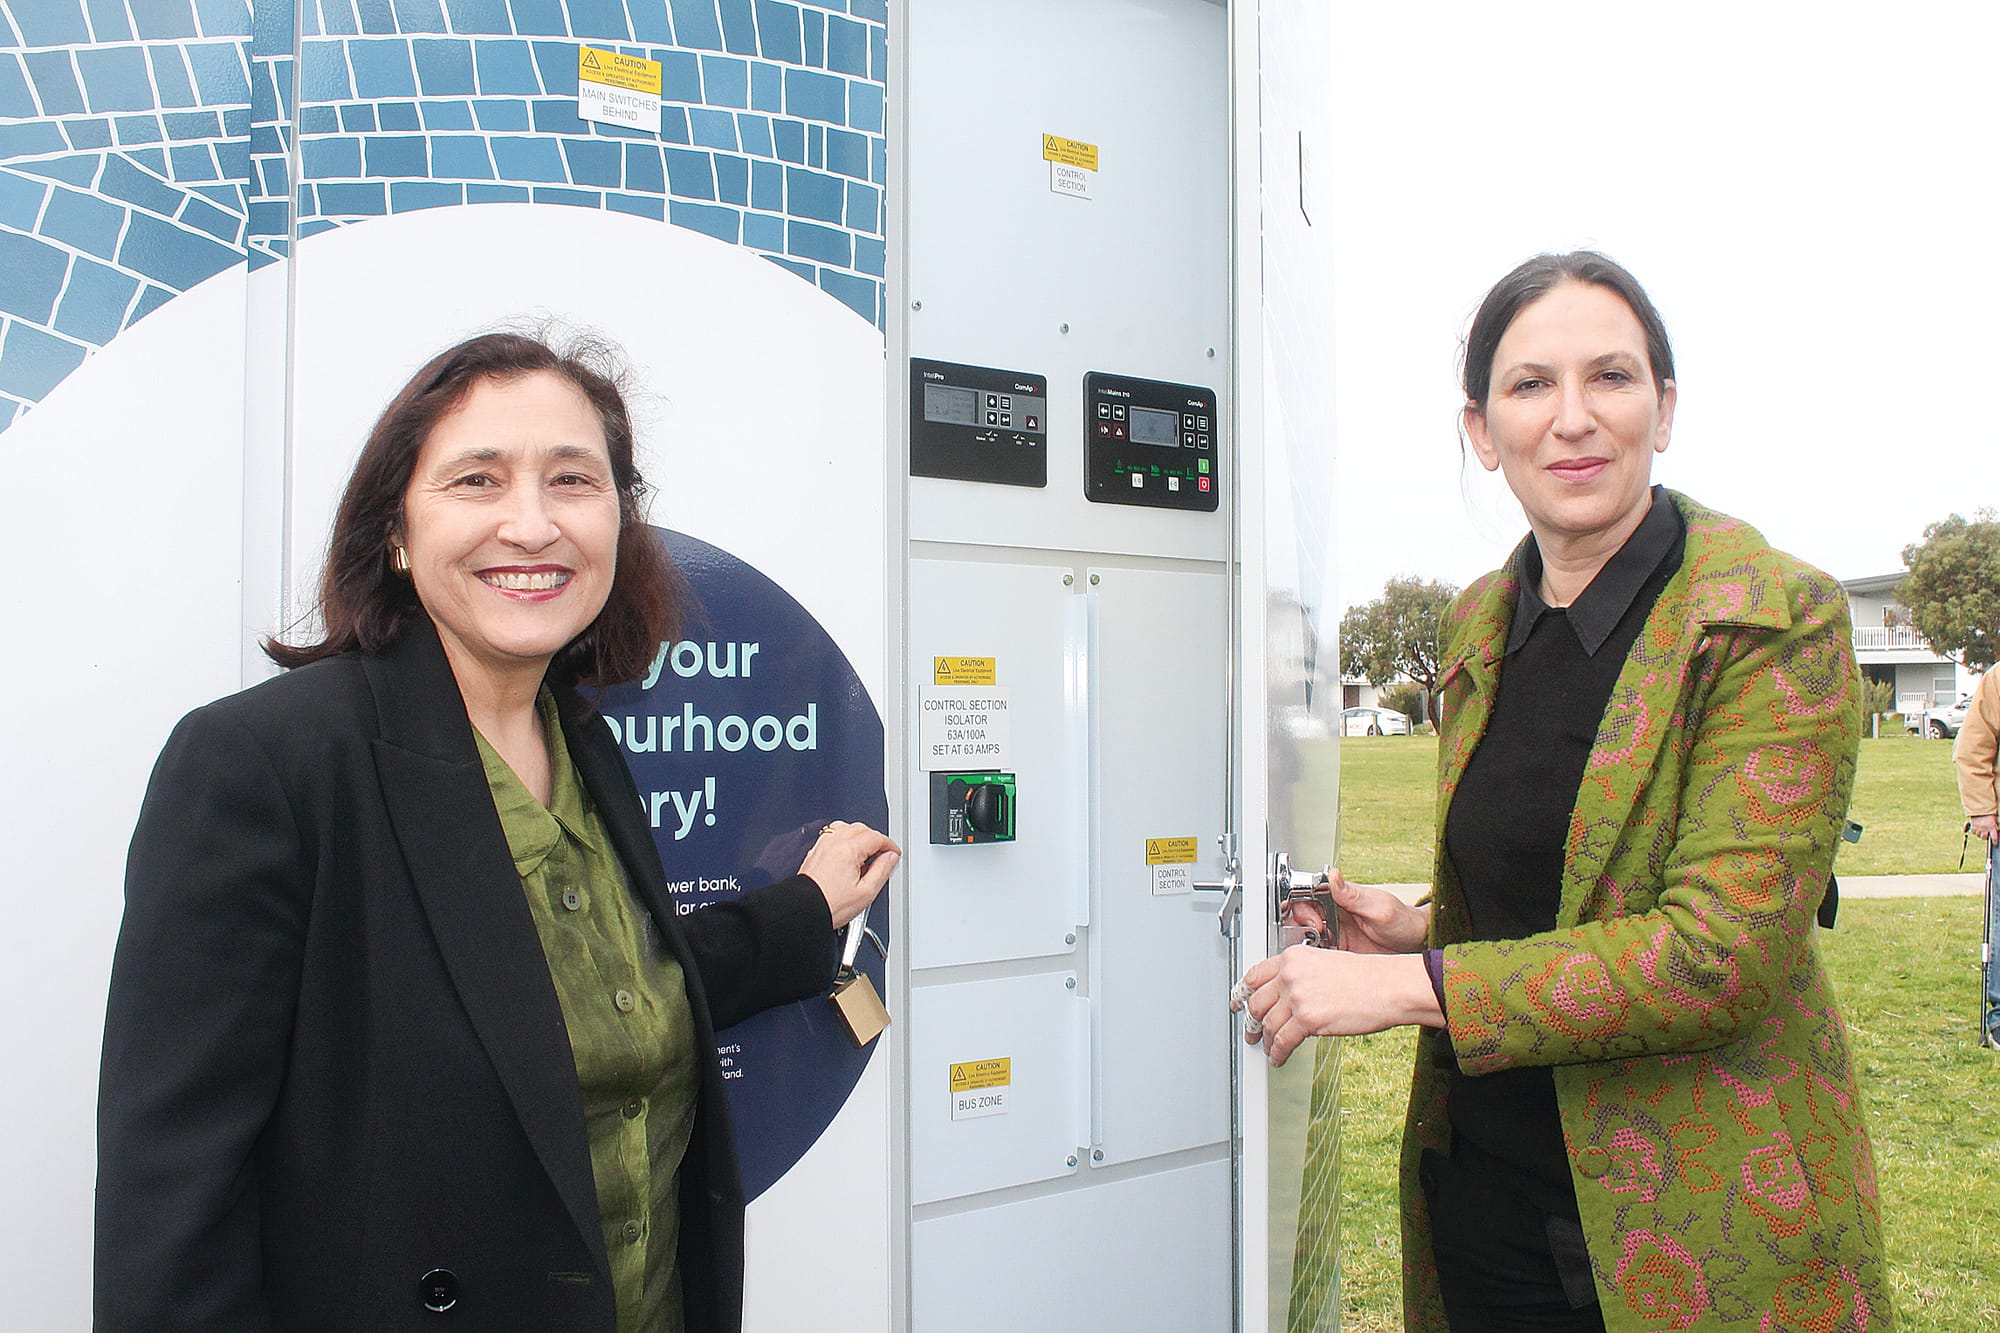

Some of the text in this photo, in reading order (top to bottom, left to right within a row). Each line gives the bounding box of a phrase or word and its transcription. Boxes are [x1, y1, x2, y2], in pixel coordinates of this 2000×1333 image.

[614, 56, 647, 70] CAUTION
[582, 87, 658, 112] MAIN SWITCHES
[602, 105, 638, 121] BEHIND
[1066, 141, 1089, 152] CAUTION
[1057, 167, 1087, 182] CONTROL
[1058, 178, 1086, 192] SECTION
[641, 640, 760, 690] your
[960, 659, 985, 667] CAUTION
[924, 699, 1007, 711] CONTROL SECTION
[944, 714, 988, 726] ISOLATOR
[947, 729, 986, 740] 63A/100A
[932, 743, 1000, 755] SET AT 63 AMPS
[639, 777, 717, 841] ry!
[1168, 840, 1189, 848] CAUTION
[1158, 868, 1187, 878] CONTROL
[666, 875, 742, 894] wer bank,
[1159, 880, 1186, 890] SECTION
[675, 900, 696, 916] lar
[720, 1057, 734, 1068] ith
[976, 1061, 1001, 1071] CAUTION
[958, 1094, 1003, 1111] BUS ZONE
